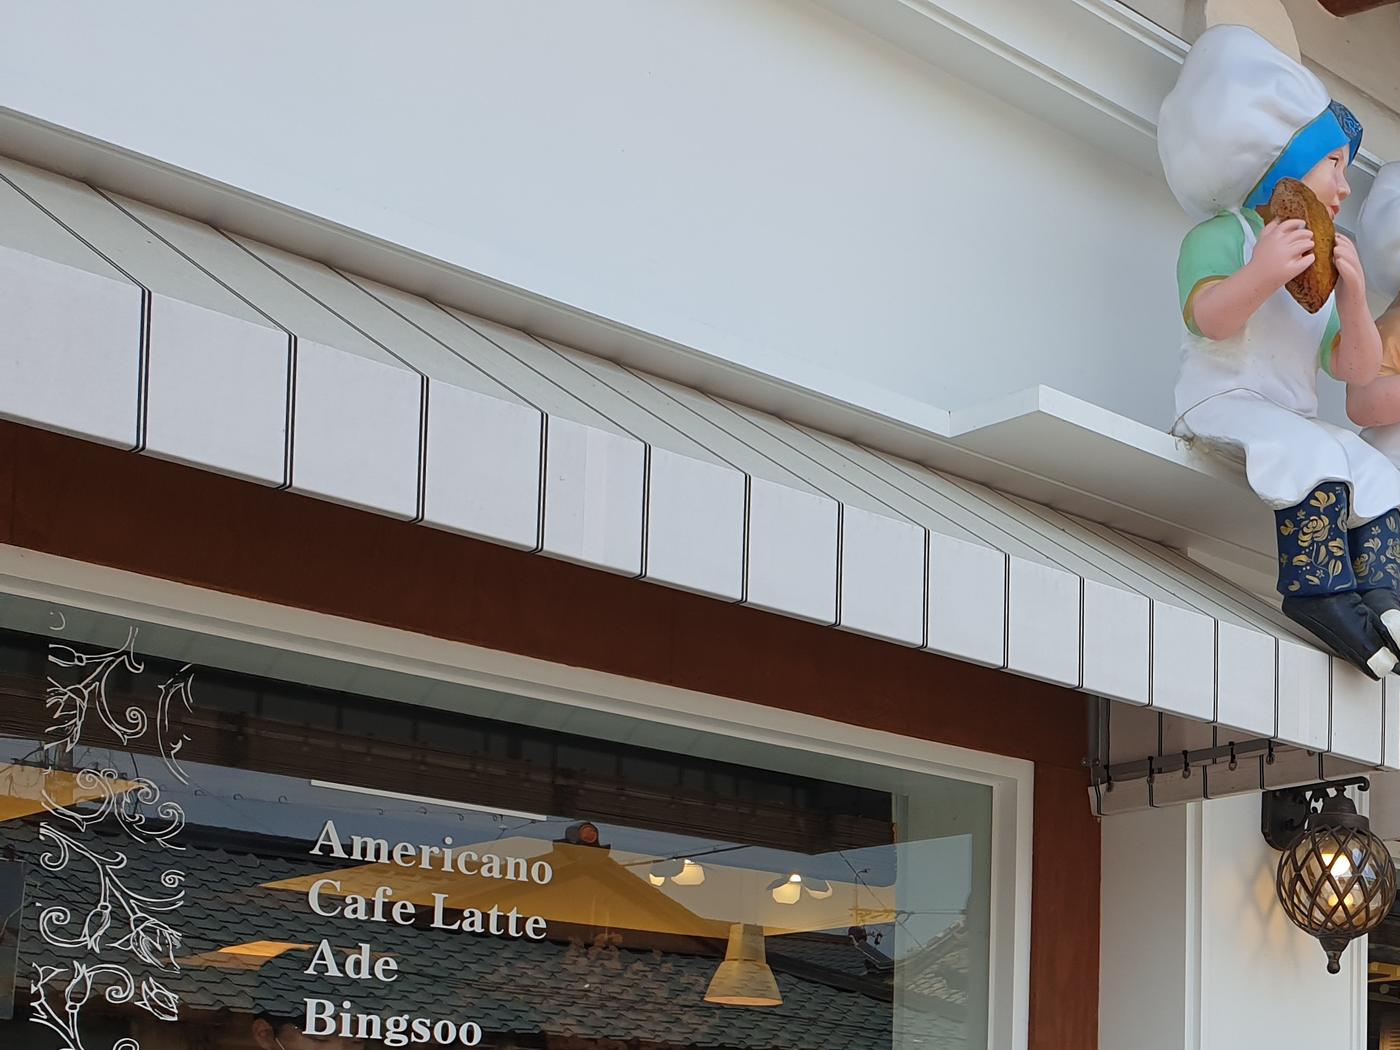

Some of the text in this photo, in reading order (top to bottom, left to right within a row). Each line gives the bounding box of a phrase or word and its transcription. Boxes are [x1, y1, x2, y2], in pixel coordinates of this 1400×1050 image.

[310, 820, 554, 886] Americano
[308, 879, 548, 941] Cafe Latte
[304, 939, 398, 983] Ade
[302, 999, 483, 1048] Bingsoo
